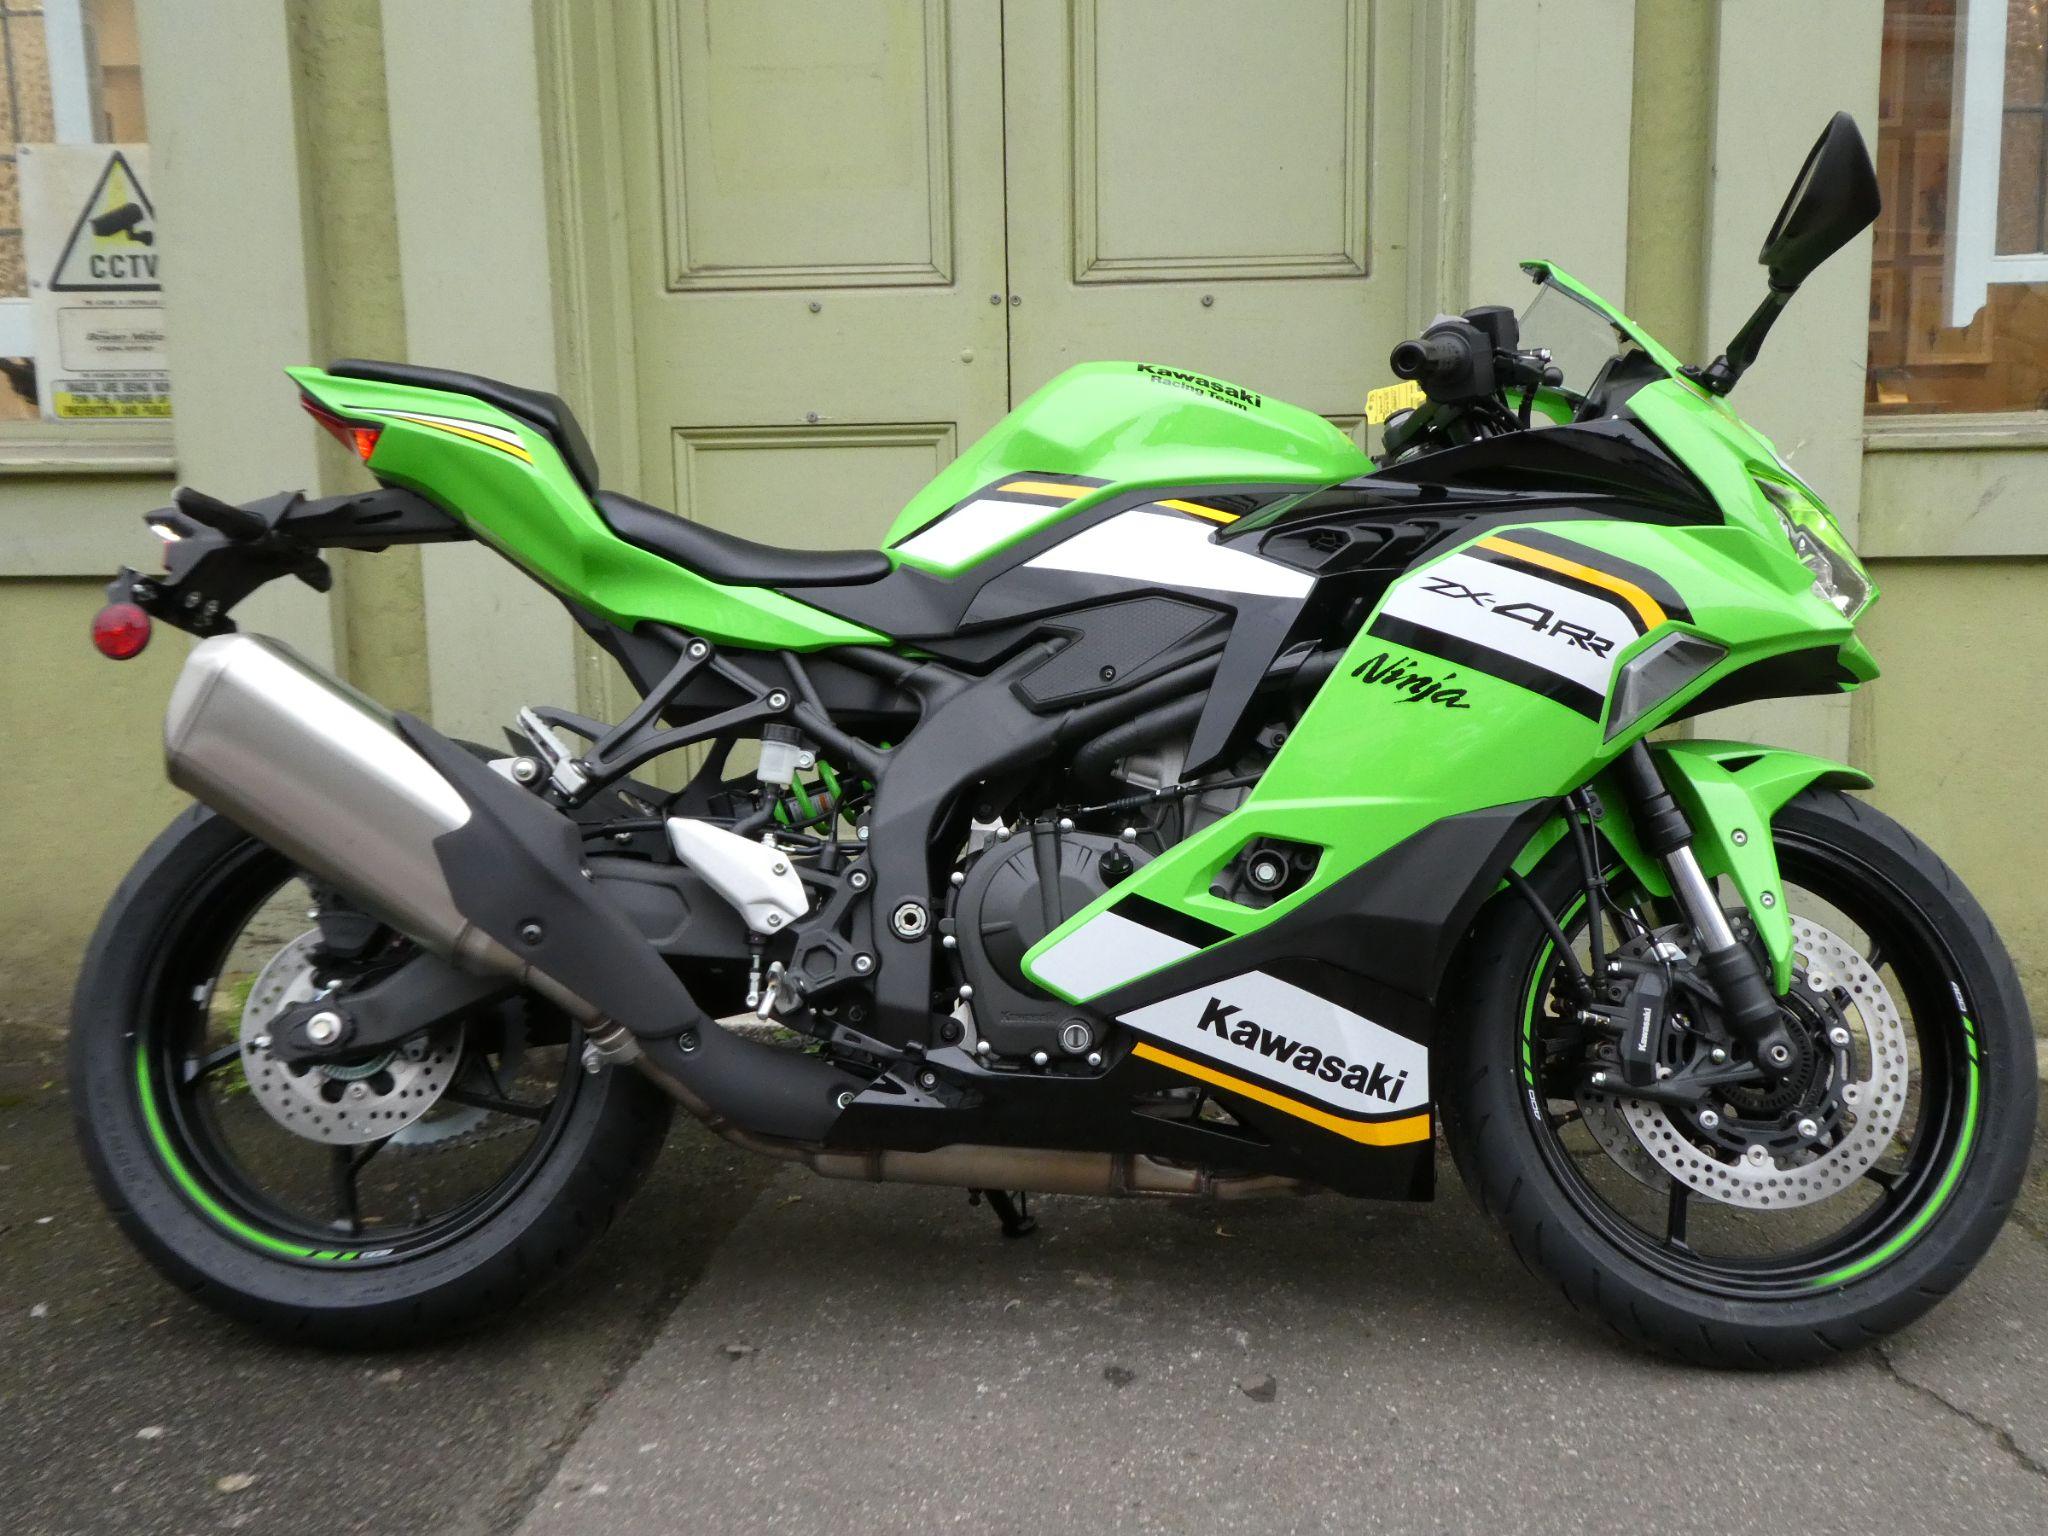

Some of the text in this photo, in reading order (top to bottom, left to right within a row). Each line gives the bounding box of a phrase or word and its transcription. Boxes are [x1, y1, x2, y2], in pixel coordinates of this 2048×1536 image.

[90, 254, 159, 278] CCTV
[1137, 363, 1262, 408] Kawasaki
[1151, 375, 1248, 411] Racing Team
[1419, 577, 1615, 659] ZX-4RR
[1351, 652, 1470, 709] Ninja
[1197, 997, 1409, 1103] Kawasaki
[1638, 1007, 1652, 1052] Kawasaki
